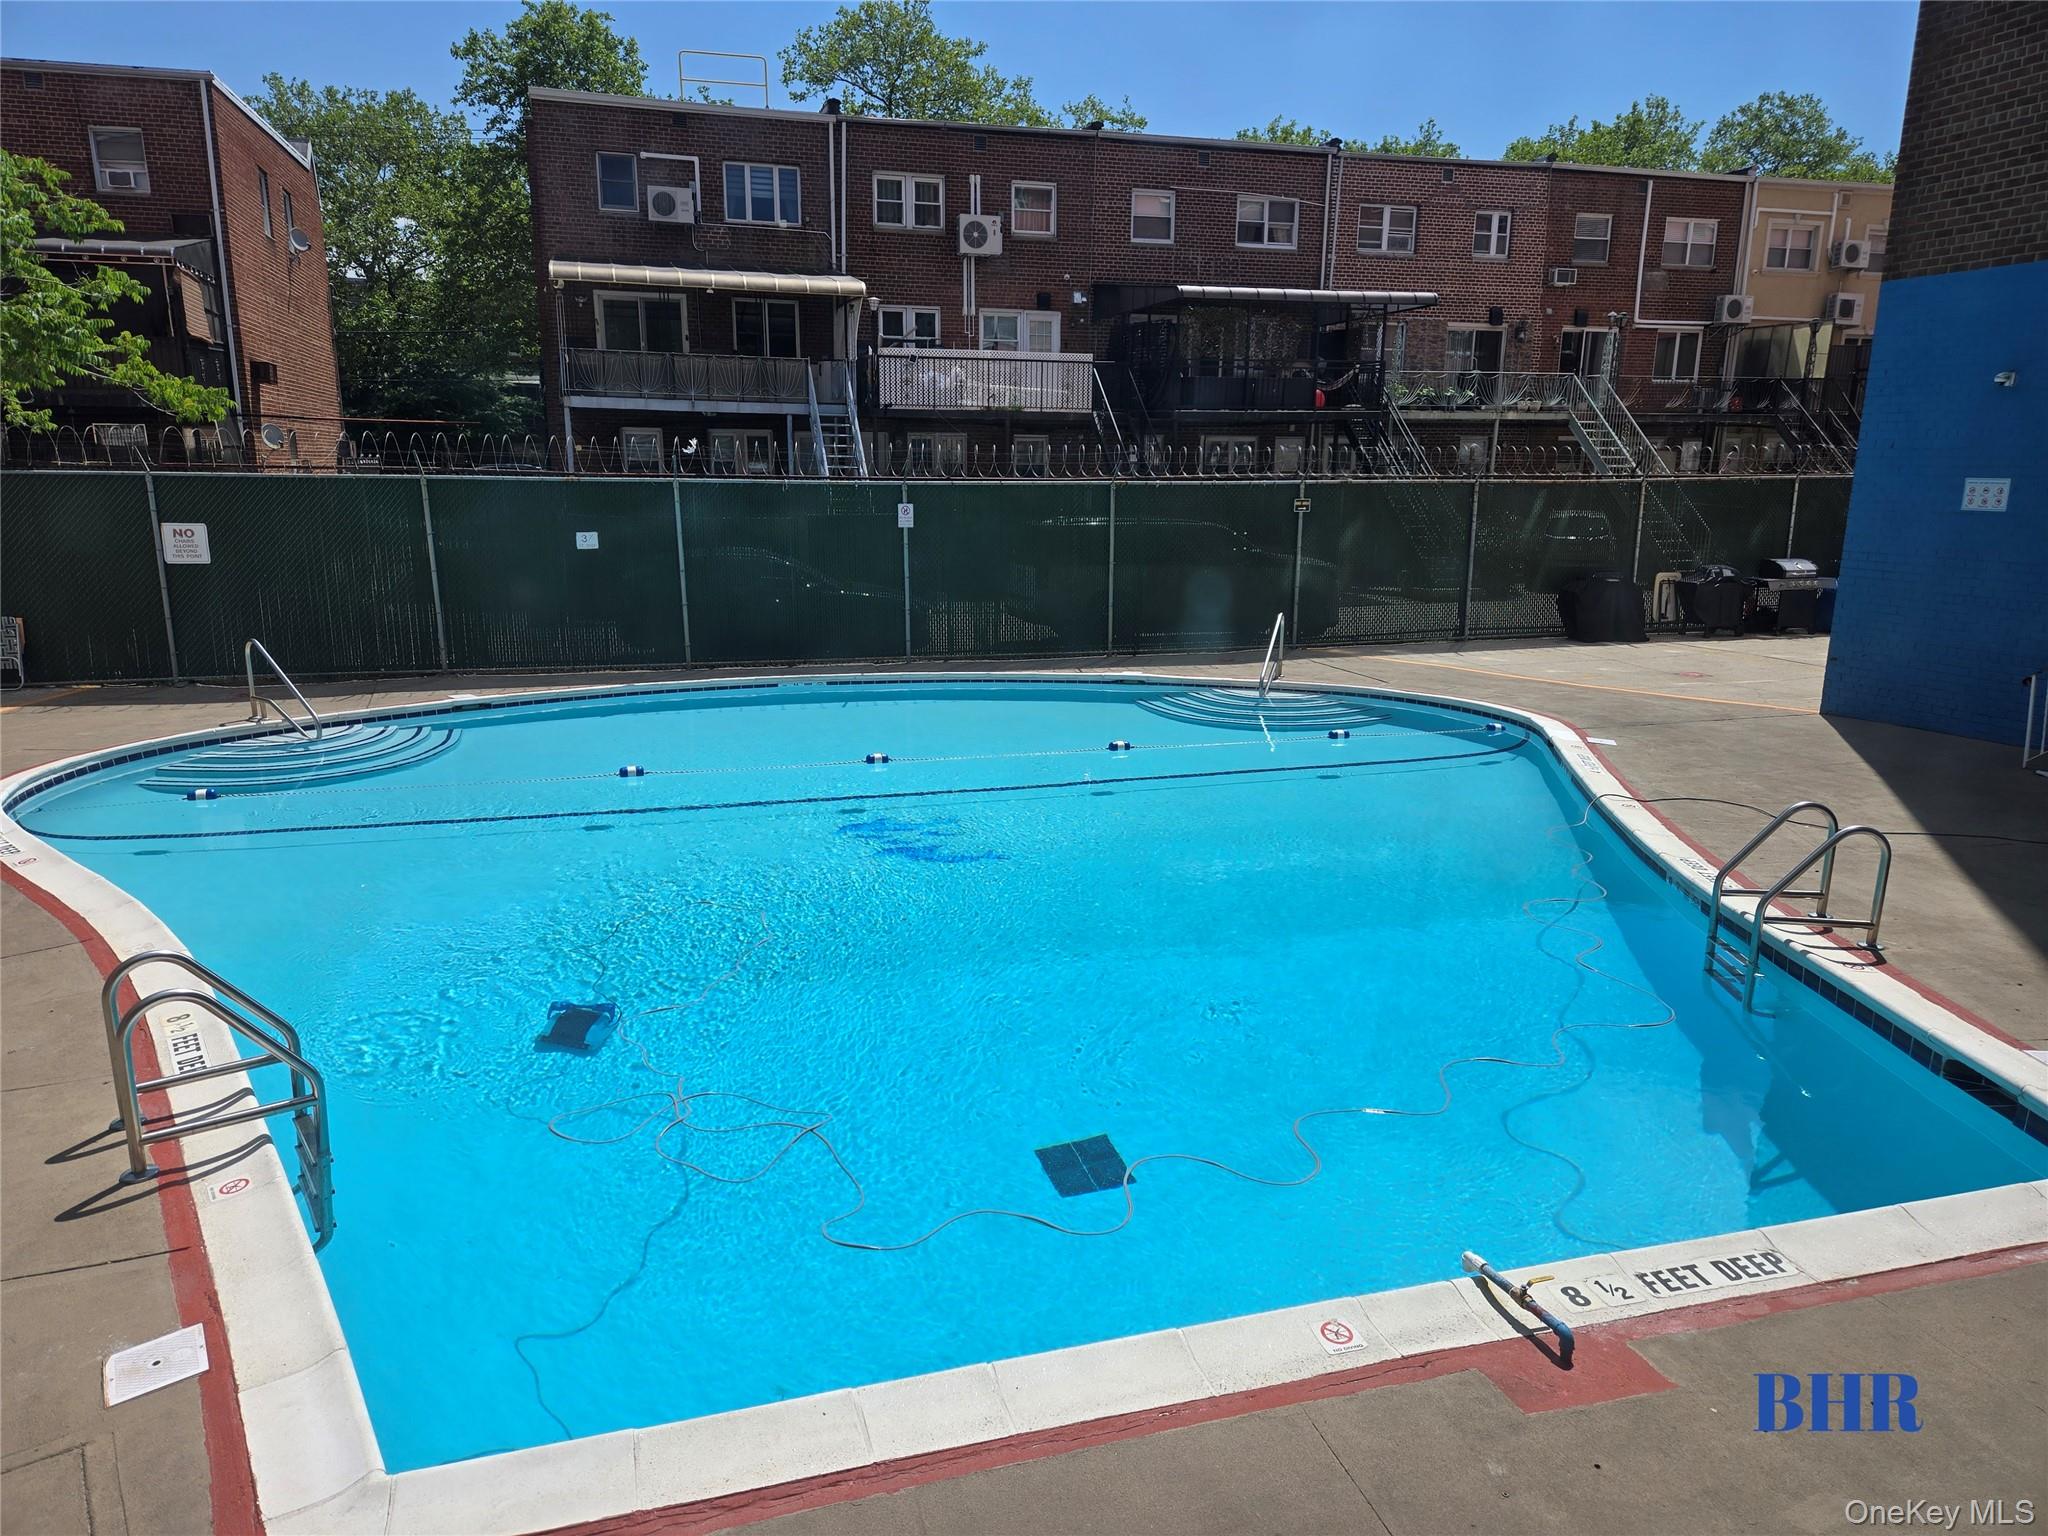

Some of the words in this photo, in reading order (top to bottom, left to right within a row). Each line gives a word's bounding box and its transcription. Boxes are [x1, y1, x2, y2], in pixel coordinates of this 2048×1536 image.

[173, 528, 195, 538] NO
[166, 1013, 191, 1023] 8
[171, 1033, 201, 1056] FEET
[1560, 1286, 1592, 1307] 8
[1634, 1263, 1713, 1295] FEET
[1709, 1251, 1788, 1283] DEEP
